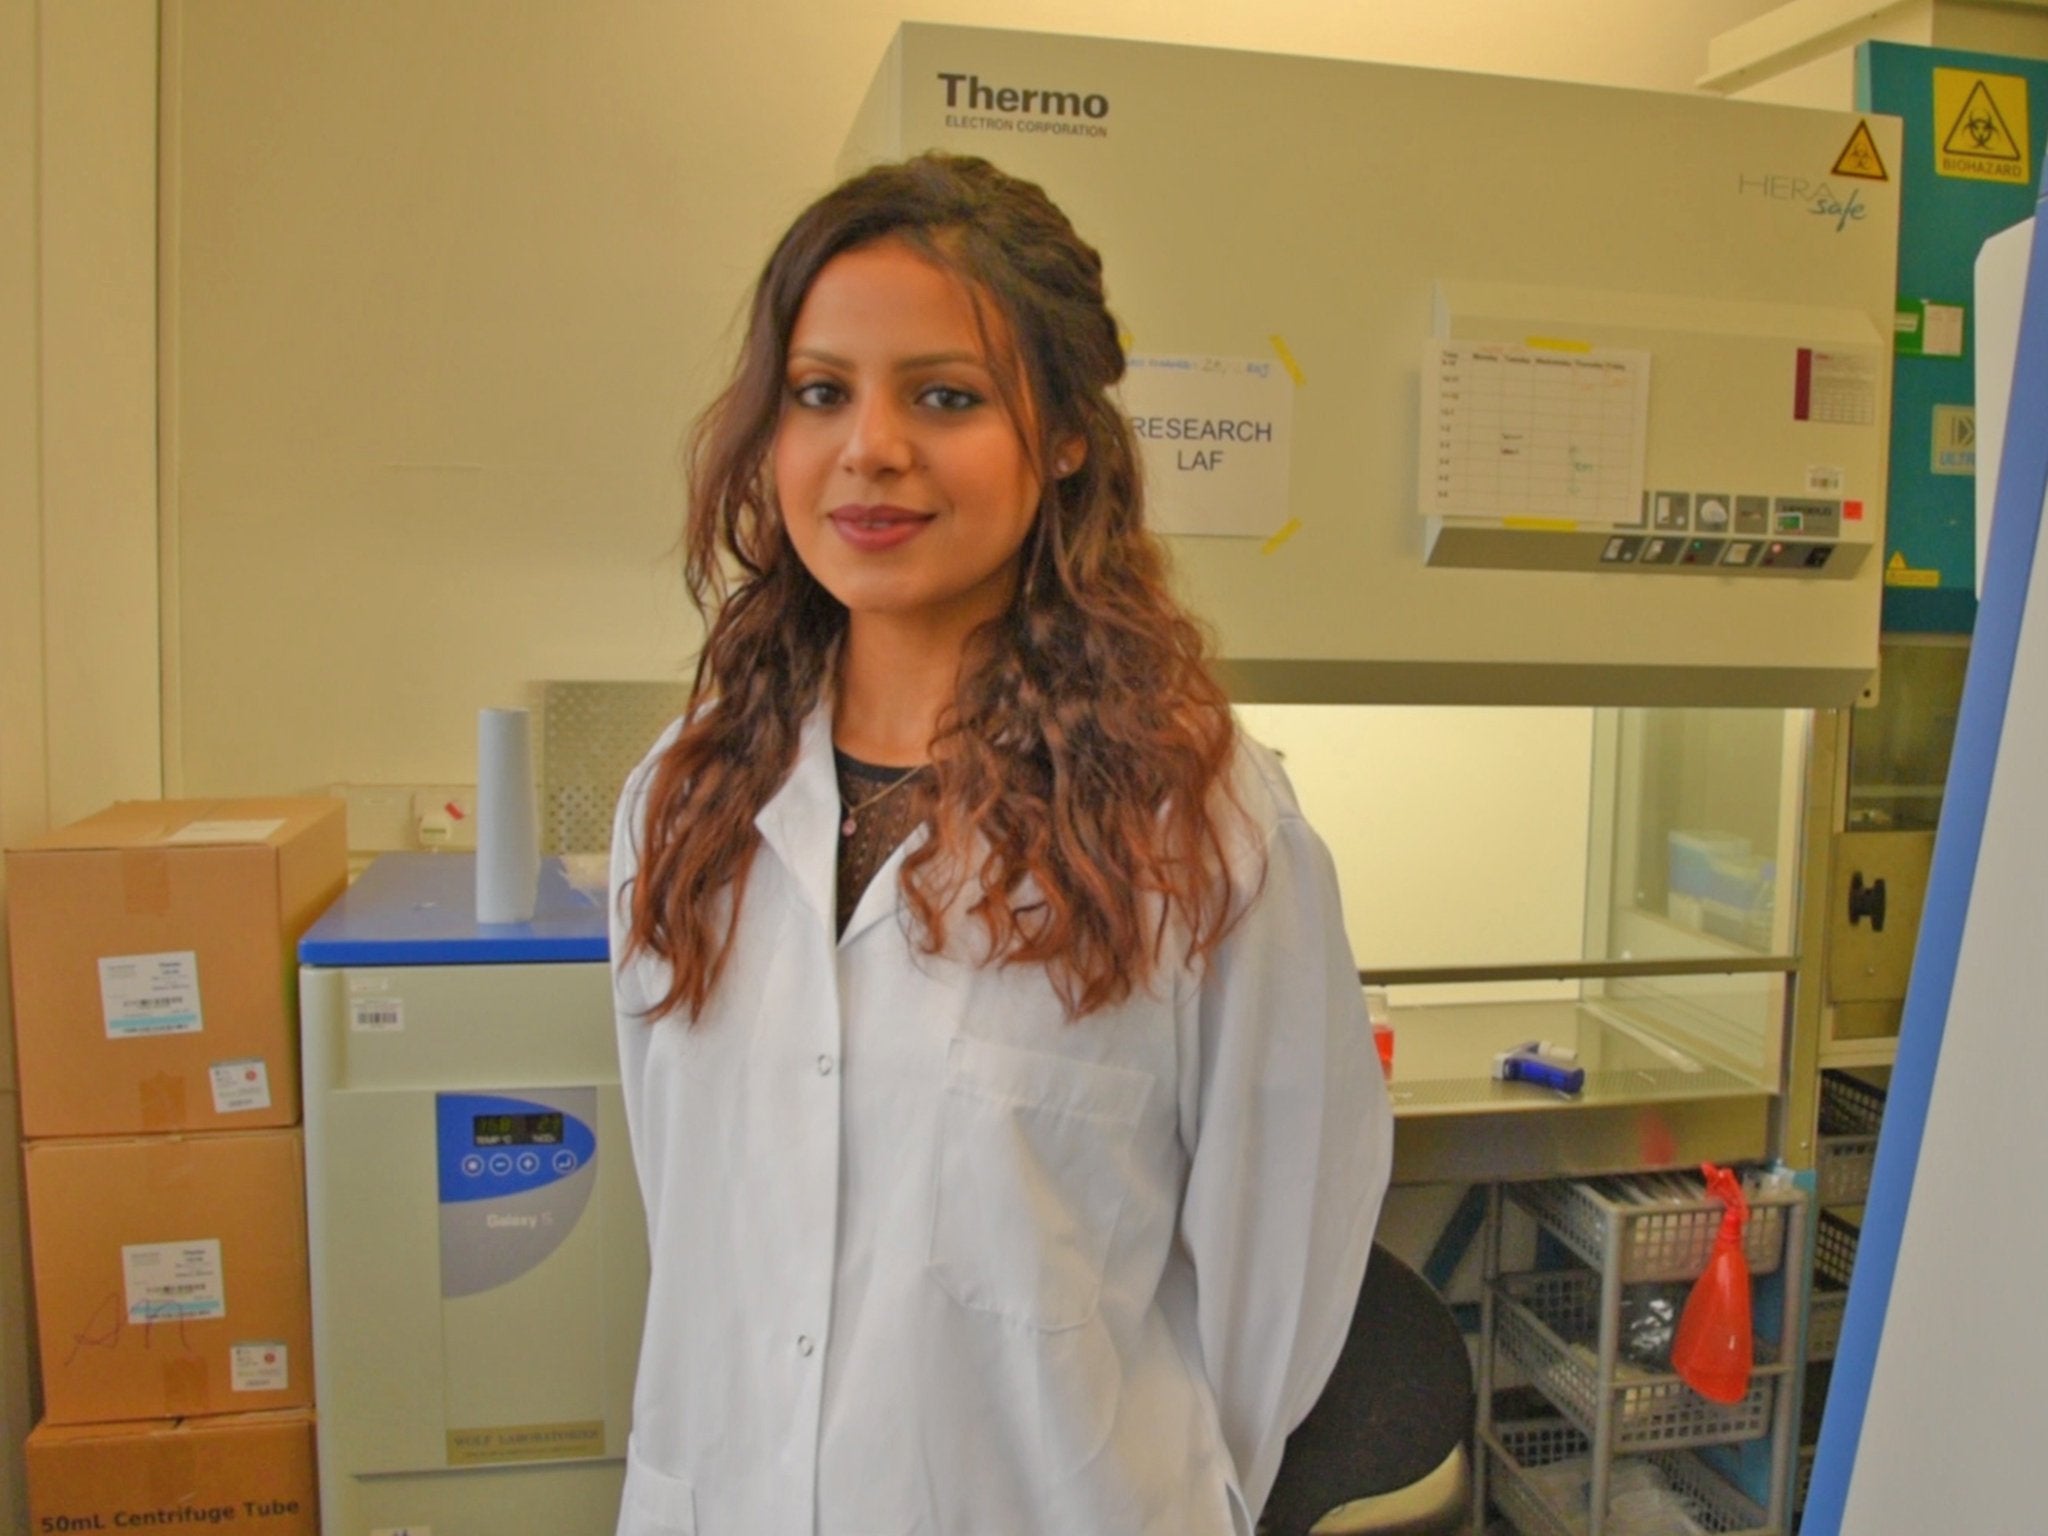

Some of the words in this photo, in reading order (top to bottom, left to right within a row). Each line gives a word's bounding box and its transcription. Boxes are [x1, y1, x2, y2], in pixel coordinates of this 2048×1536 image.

[937, 73, 1109, 119] Thermo
[945, 115, 1013, 131] ELECTRON
[1016, 120, 1107, 137] CORPORATION
[1943, 157, 2021, 177] BIOHAZARD
[1739, 174, 1838, 201] HERA
[1807, 189, 1867, 232] safe
[1132, 417, 1272, 442] RESEARCH
[1177, 451, 1224, 471] LAF
[41, 1514, 104, 1534] 50mL
[114, 1503, 235, 1528] Centrifuge
[244, 1500, 300, 1517] Tube
